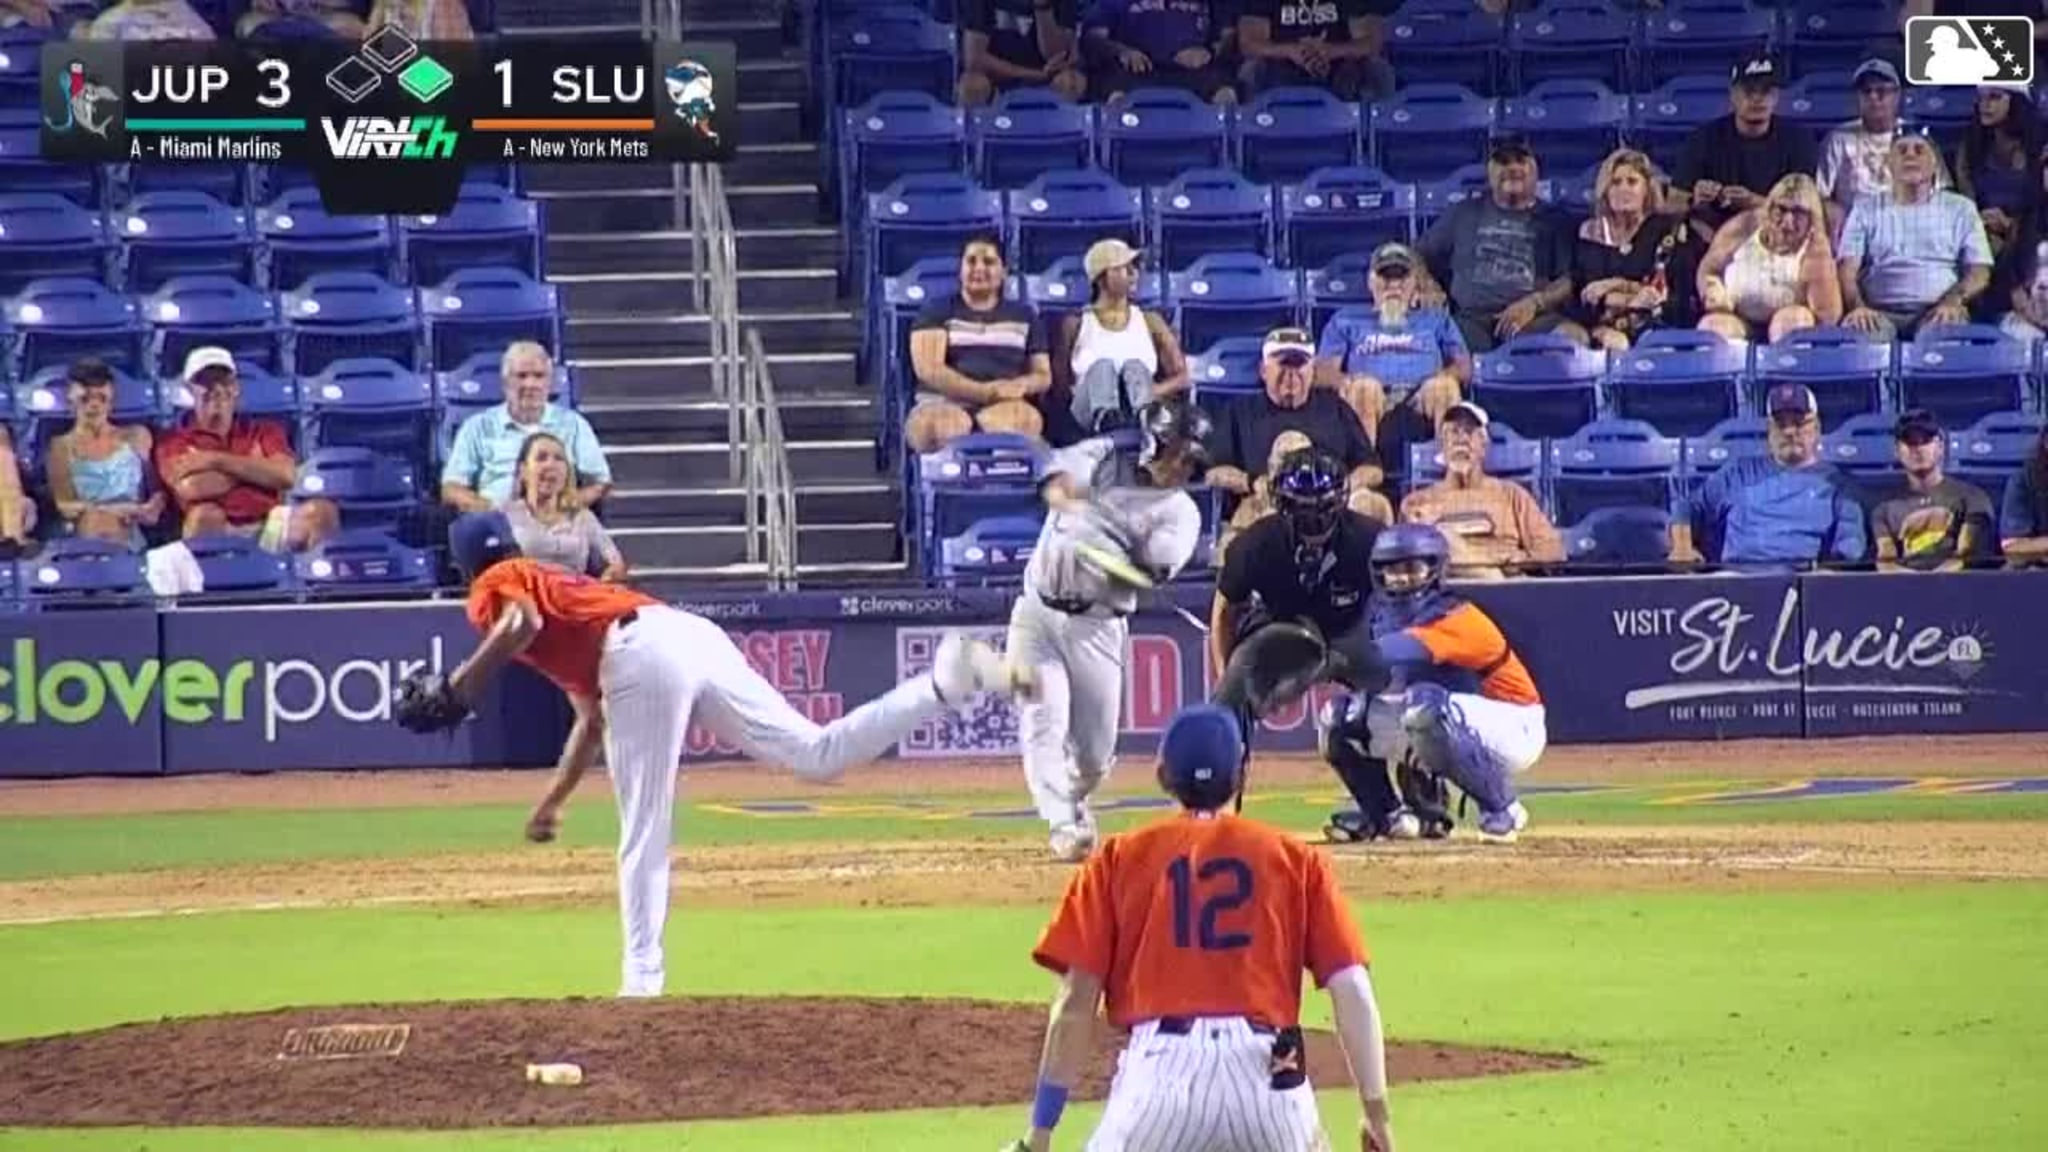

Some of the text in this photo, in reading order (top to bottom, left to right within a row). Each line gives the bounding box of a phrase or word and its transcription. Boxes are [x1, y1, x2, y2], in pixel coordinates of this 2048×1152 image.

[1613, 608, 1676, 636] VISIT
[1671, 597, 1757, 673] St.
[1766, 587, 1950, 675] Lucie
[1166, 854, 1254, 950] 12
